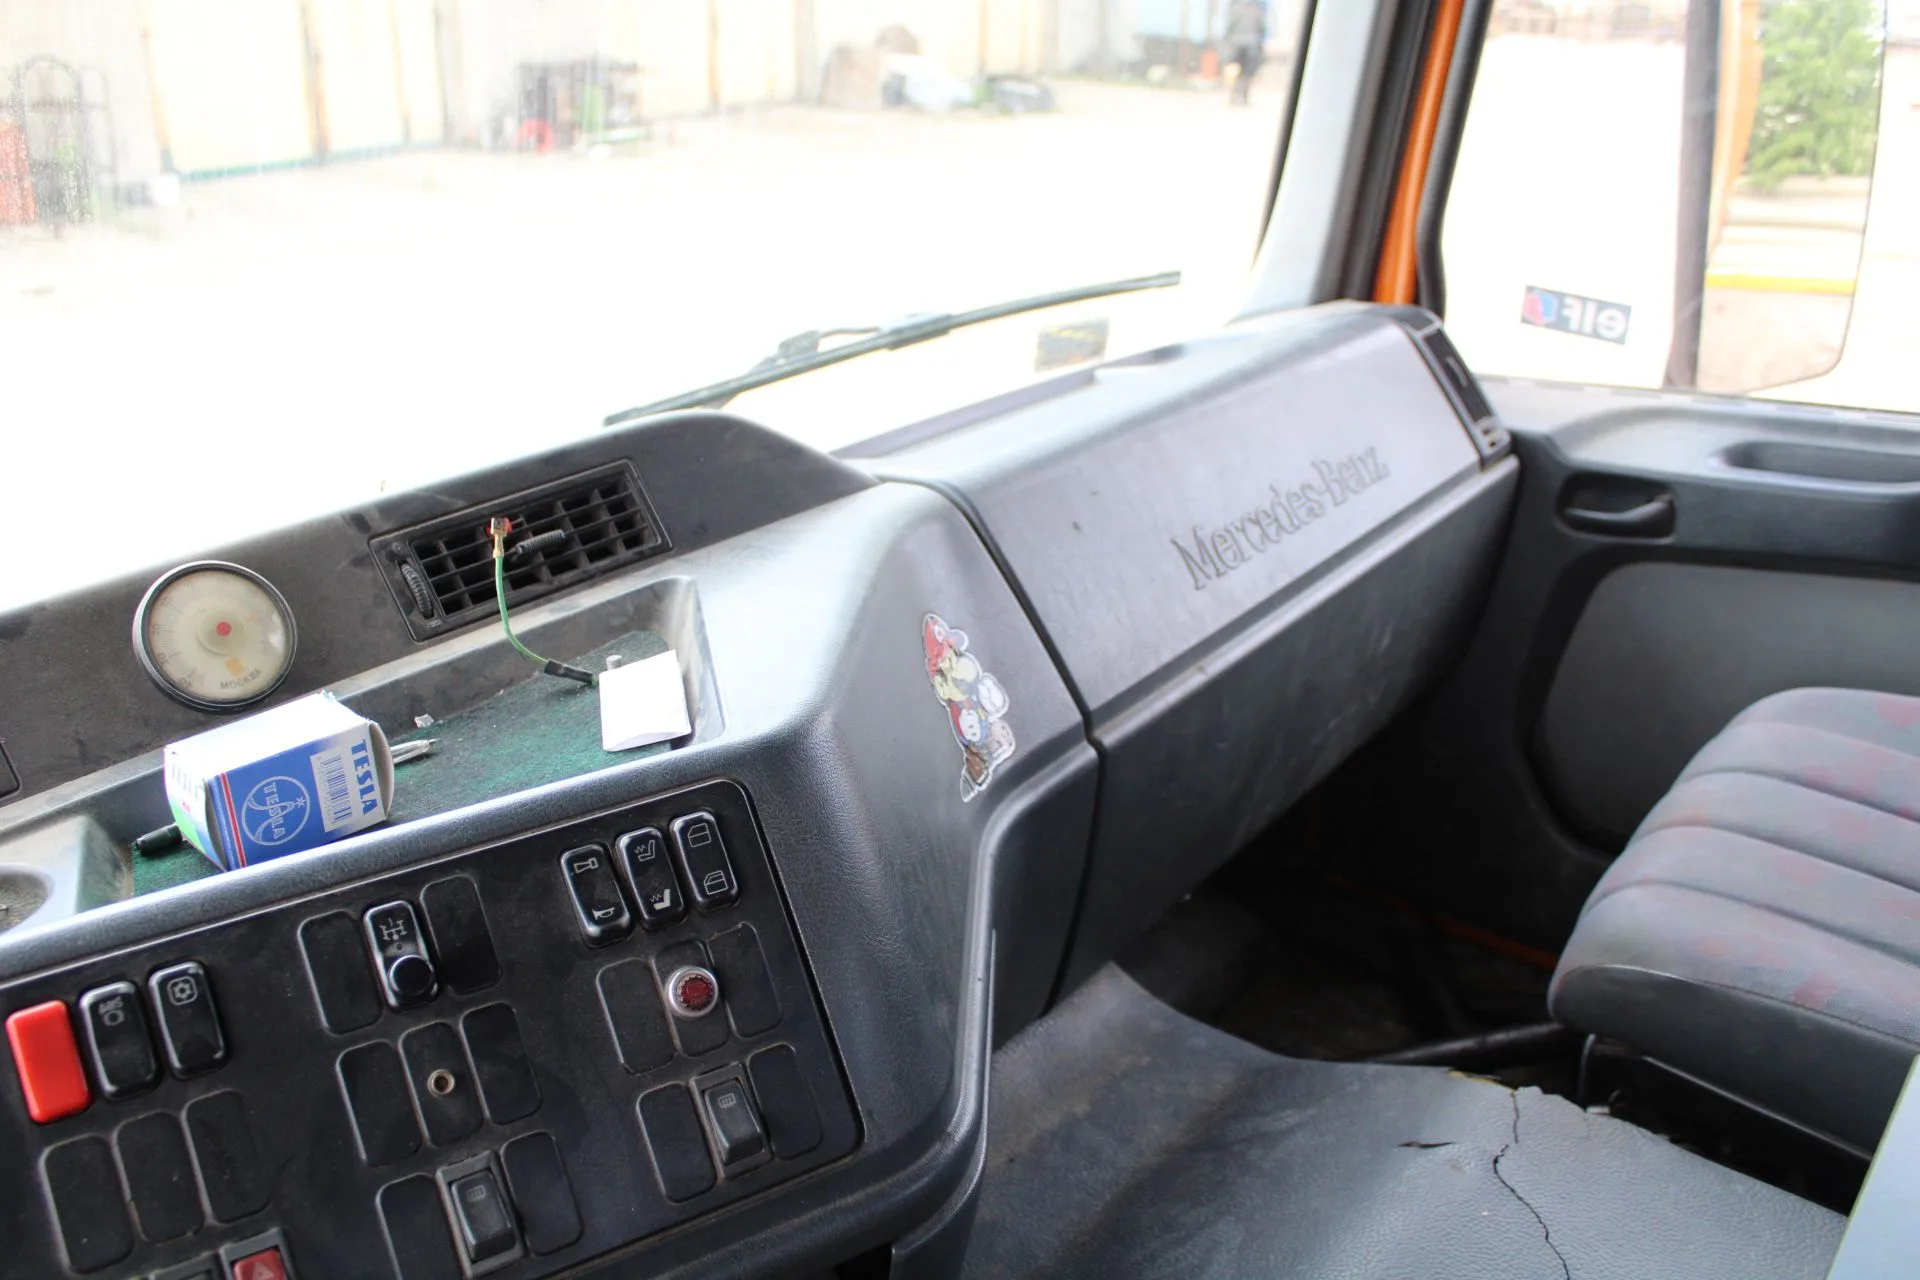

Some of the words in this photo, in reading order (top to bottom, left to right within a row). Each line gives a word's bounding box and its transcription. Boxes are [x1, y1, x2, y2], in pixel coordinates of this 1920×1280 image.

[1170, 445, 1391, 592] Mercedes-Benz
[263, 781, 287, 840] TESLA
[350, 738, 378, 816] TESLA
